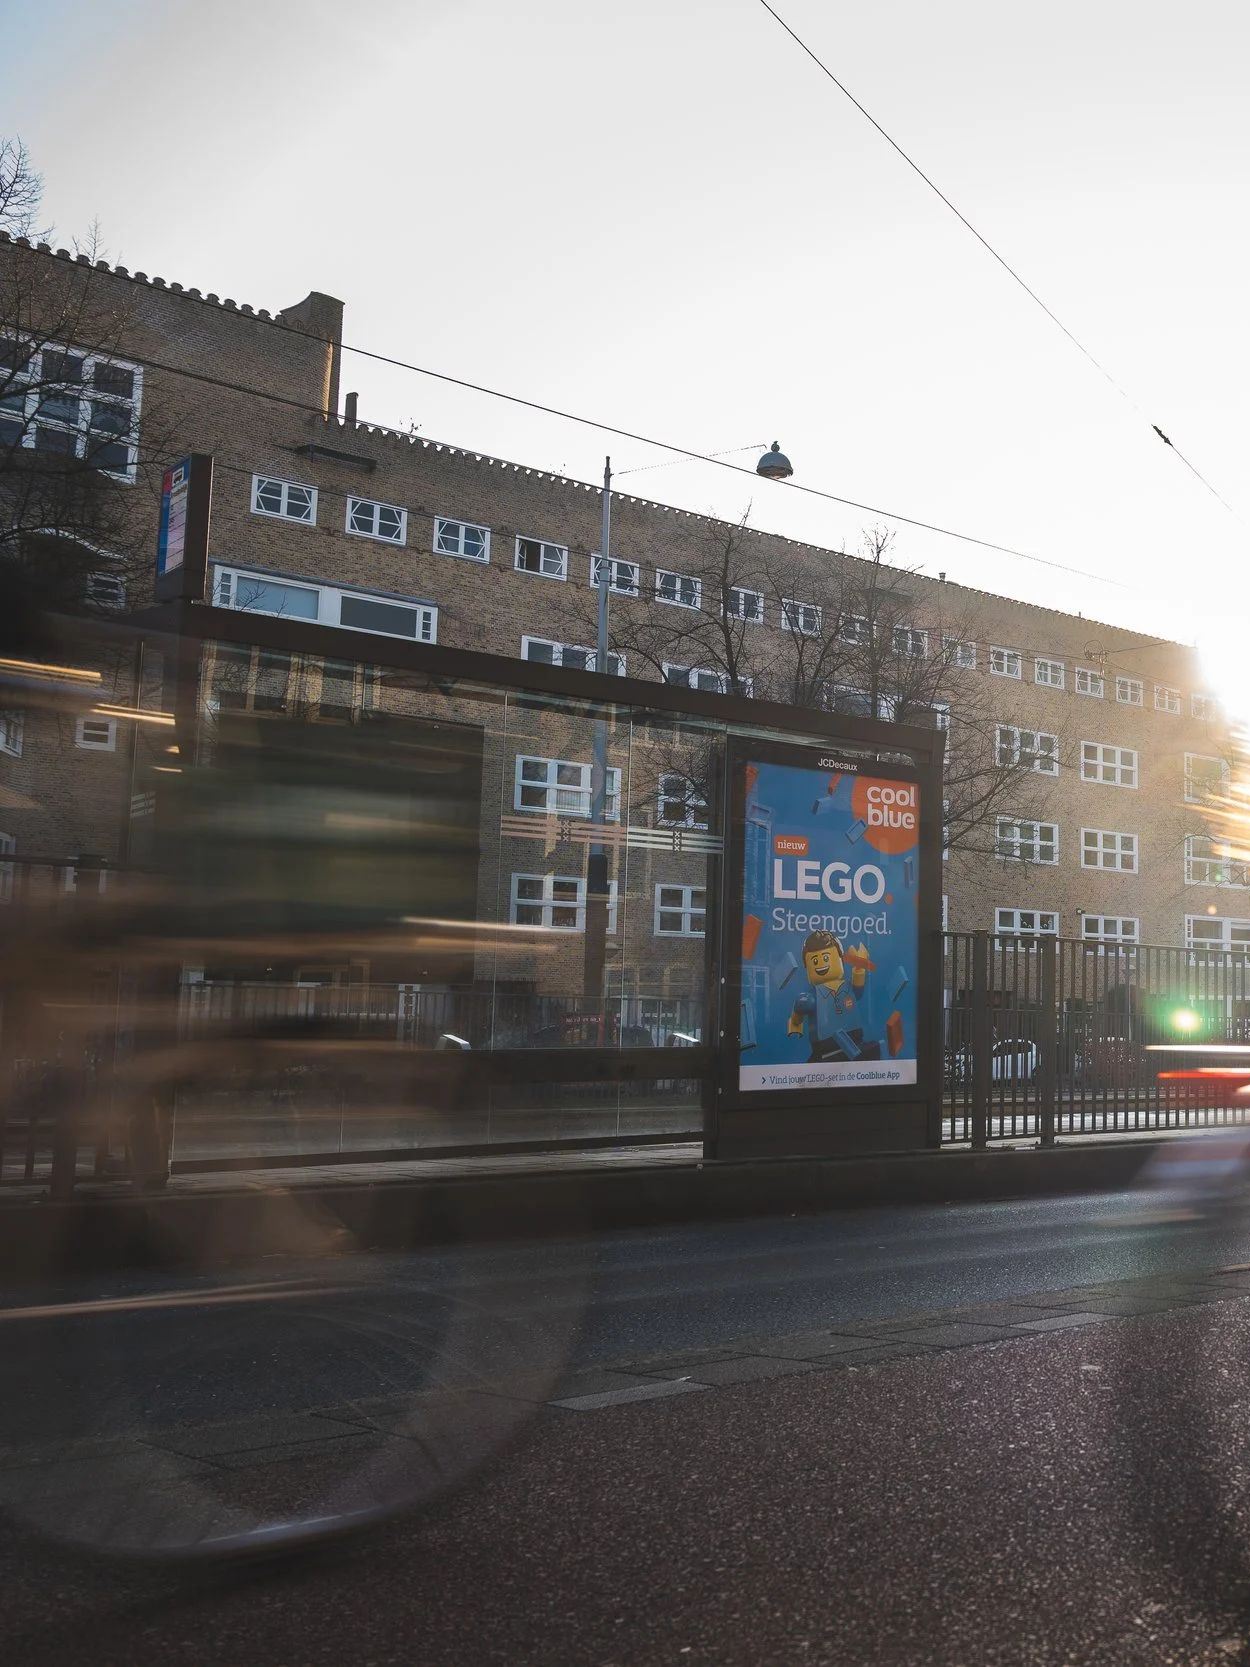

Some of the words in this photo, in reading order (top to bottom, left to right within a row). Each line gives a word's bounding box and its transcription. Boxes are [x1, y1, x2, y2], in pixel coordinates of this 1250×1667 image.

[818, 758, 858, 771] JCDecaux
[866, 786, 915, 807] cool
[867, 803, 915, 829] blue
[777, 840, 806, 850] nieuw
[772, 907, 892, 939] Steengoed.
[769, 1075, 788, 1085] Vind
[788, 1075, 806, 1085] jouw
[807, 1073, 839, 1083] LEGO-set
[839, 1073, 846, 1081] in
[847, 1072, 856, 1081] de
[856, 1071, 886, 1080] Coolblue
[887, 1071, 900, 1080] App
